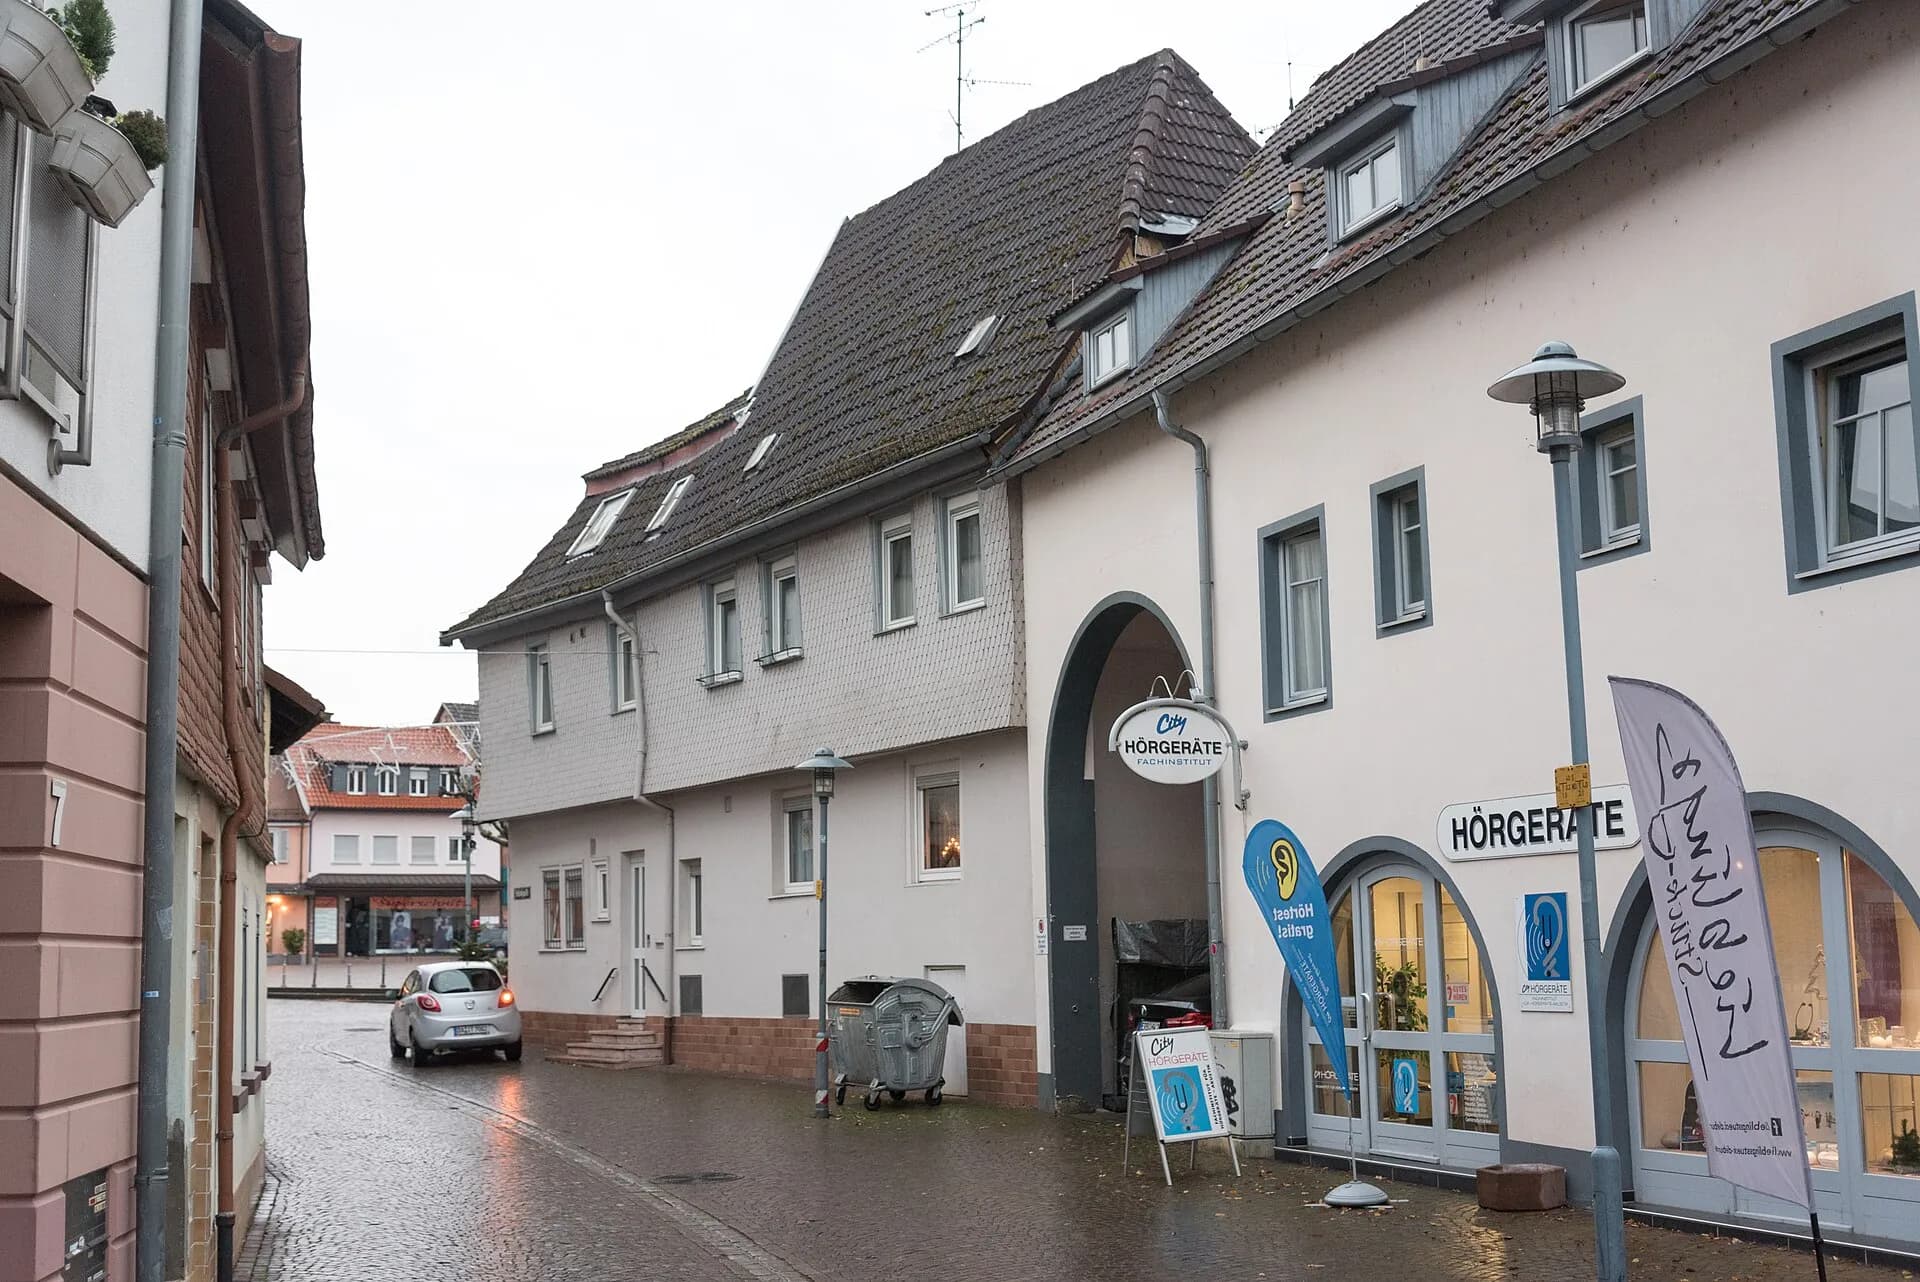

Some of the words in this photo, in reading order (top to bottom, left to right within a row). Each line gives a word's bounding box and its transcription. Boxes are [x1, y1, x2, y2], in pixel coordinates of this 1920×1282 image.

[1156, 713, 1187, 736] City
[1125, 737, 1223, 755] HÖRGERÄTE
[1137, 758, 1213, 766] FACHINSTITUT
[51, 778, 67, 847] 7
[1530, 983, 1568, 993] HÖRGERÄTE
[1151, 1036, 1174, 1056] City
[1148, 1051, 1209, 1066] HÖRGERÄTE
